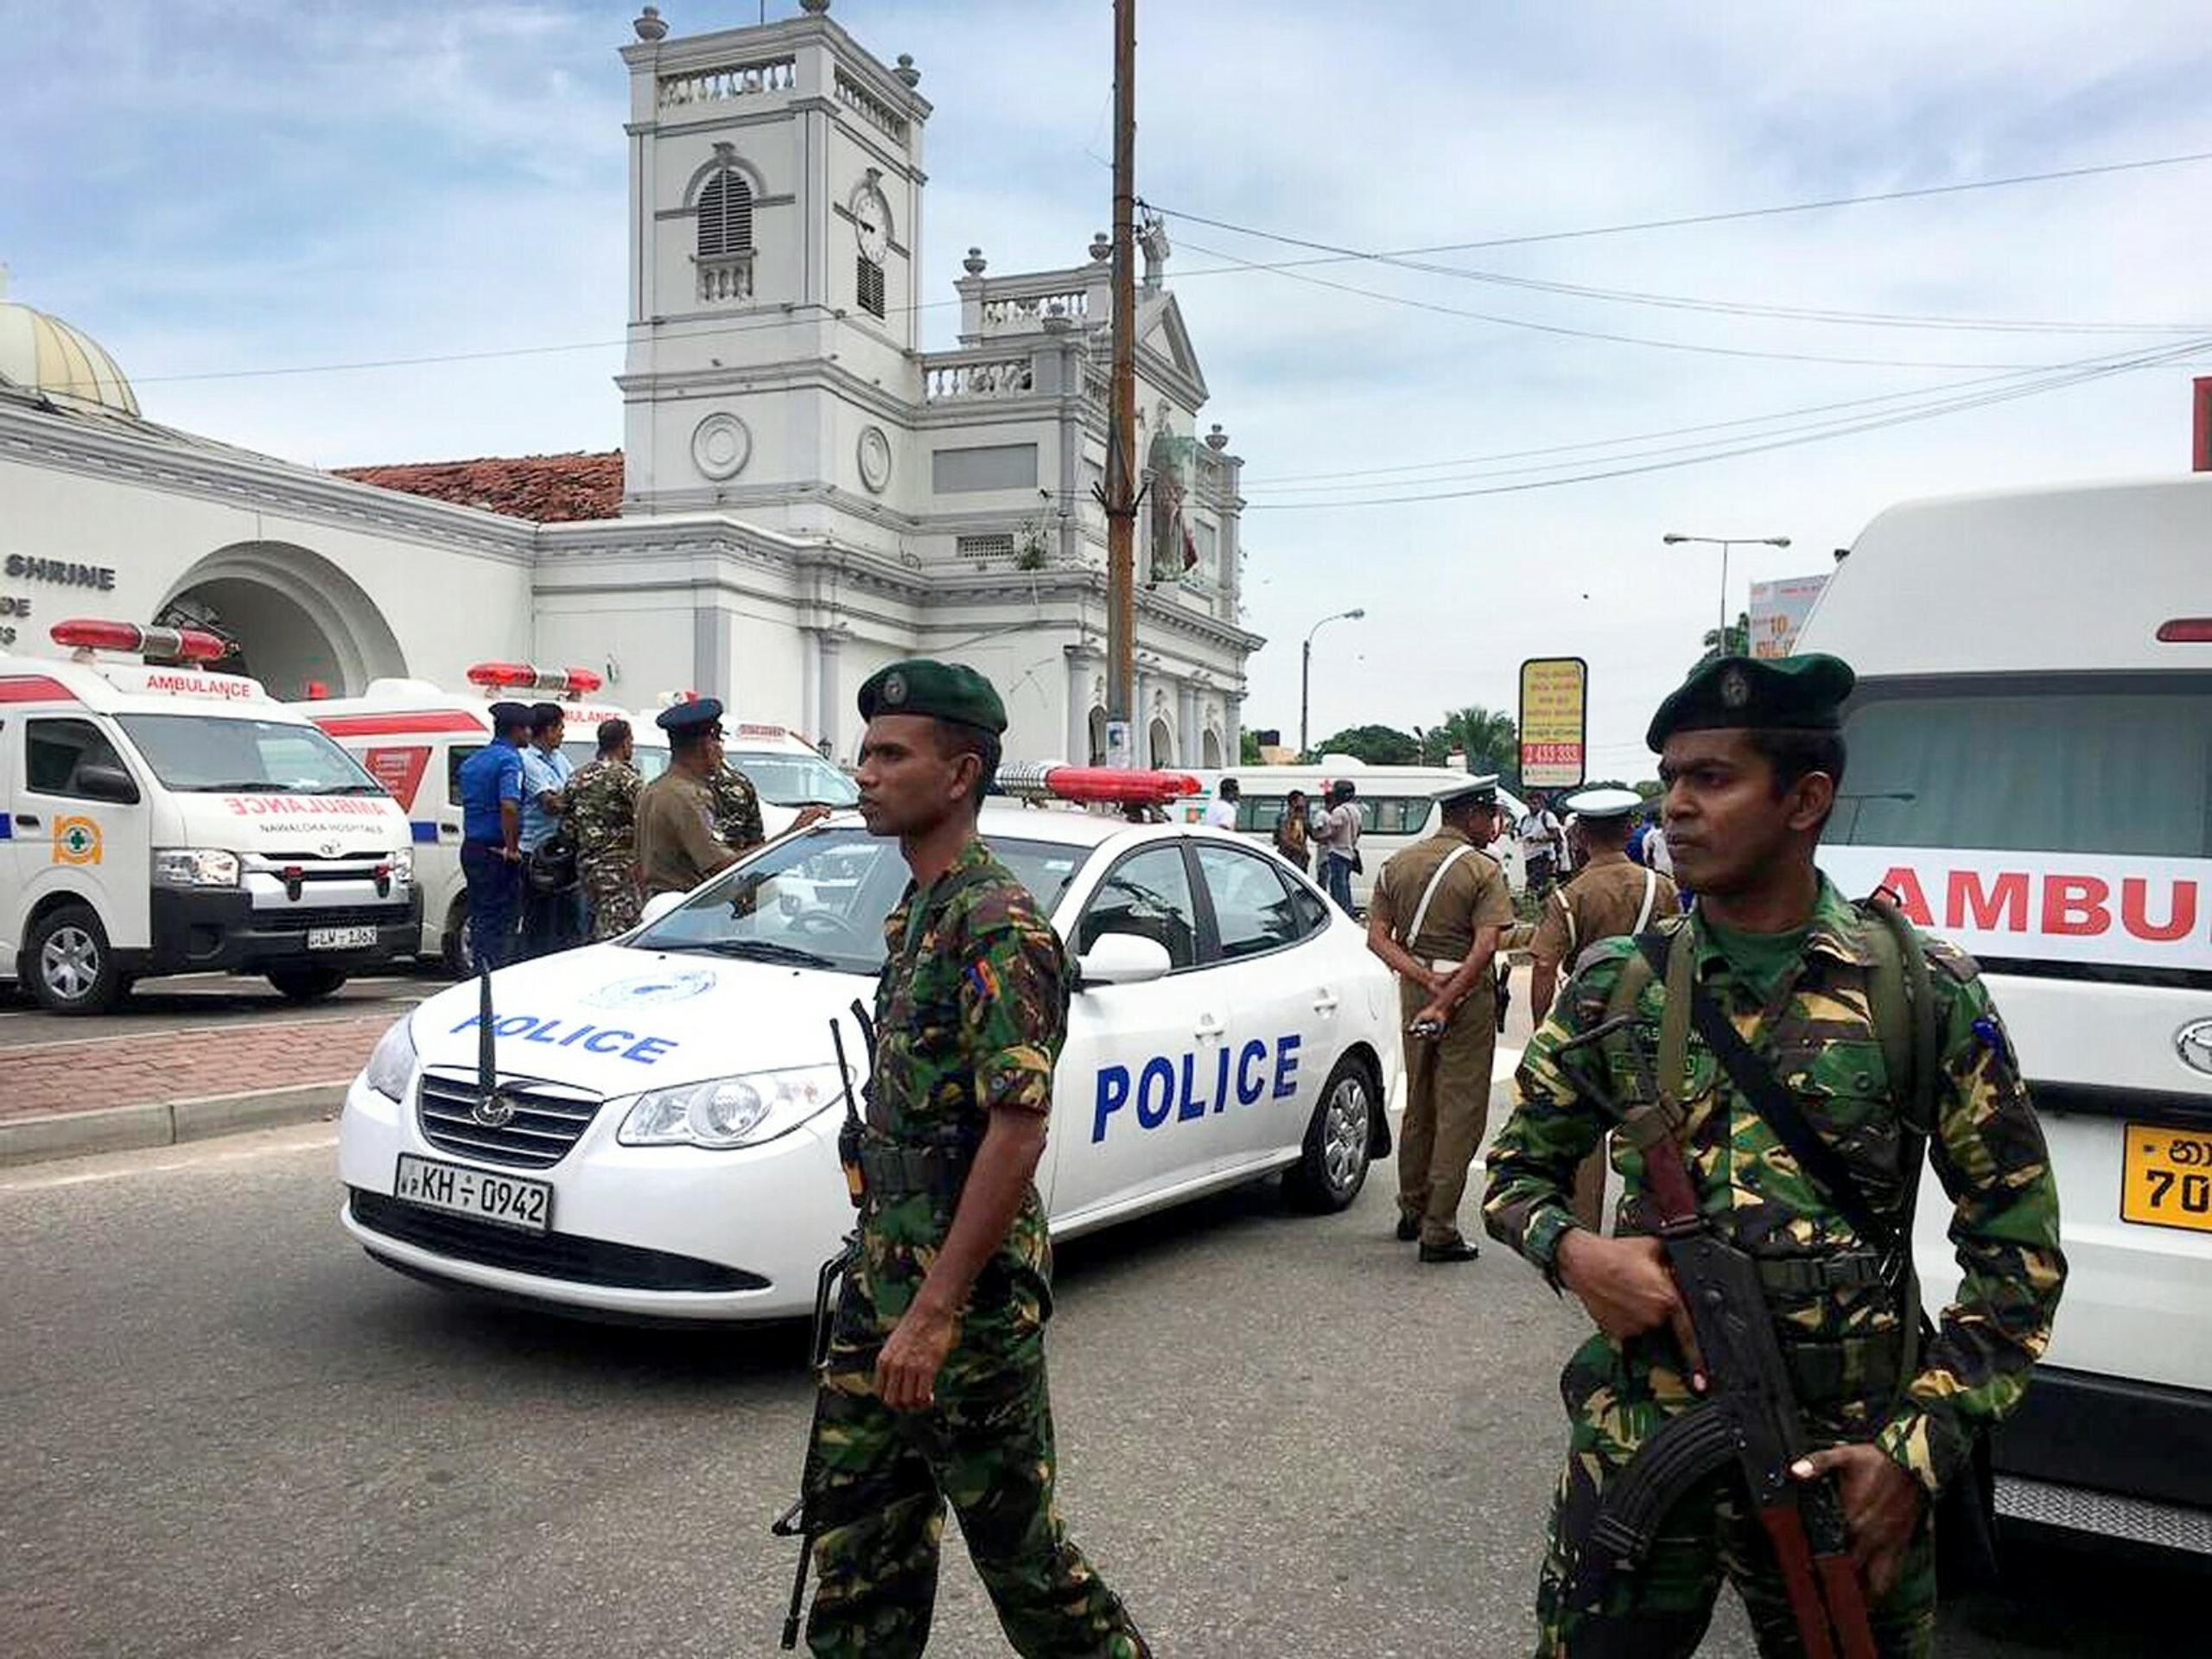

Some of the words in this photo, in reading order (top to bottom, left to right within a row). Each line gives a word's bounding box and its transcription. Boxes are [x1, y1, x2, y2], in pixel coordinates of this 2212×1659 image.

[5, 553, 116, 591] SHRINE
[147, 675, 250, 697] AMBULANCE
[1870, 867, 2212, 942] AMBU
[449, 1014, 679, 1065] POLICE
[1091, 1034, 1301, 1143] POLICE
[2146, 1168, 2210, 1213] 70
